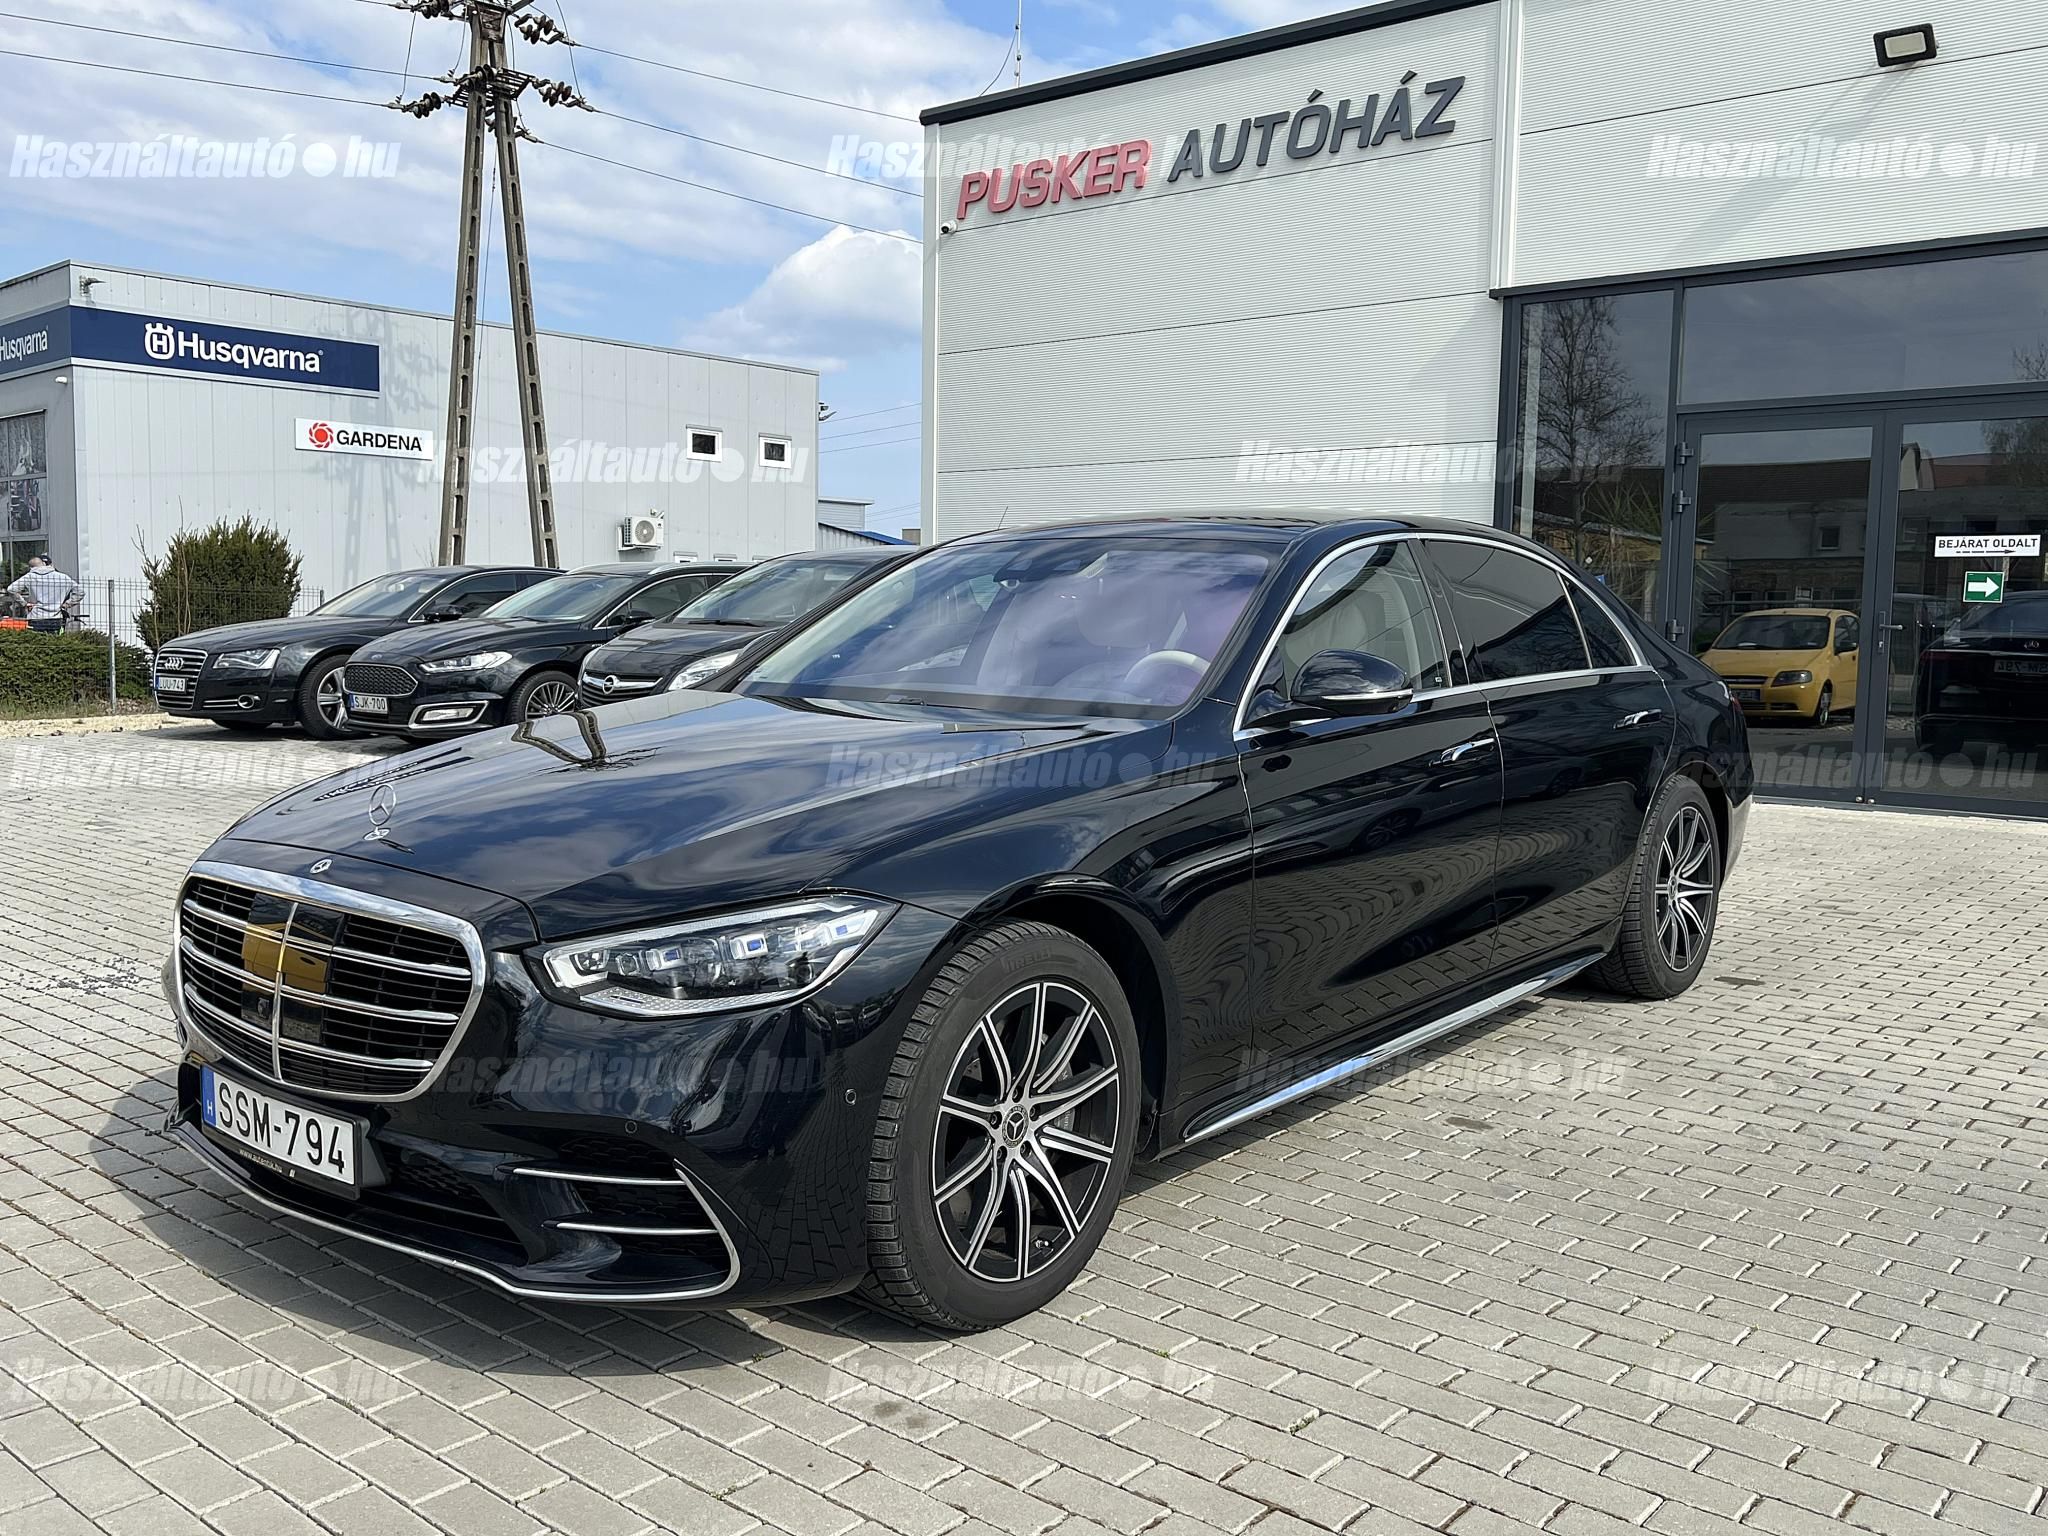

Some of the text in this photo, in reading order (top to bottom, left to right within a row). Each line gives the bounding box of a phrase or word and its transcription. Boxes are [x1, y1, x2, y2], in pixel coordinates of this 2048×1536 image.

[957, 70, 1466, 219] PUSKER AUTÓHÁZ
[0, 330, 48, 361] Husqvarna
[177, 331, 320, 373] Husqvarna
[336, 430, 422, 451] GARDENA
[1938, 537, 2038, 549] BEJÁRAT OLDALT
[354, 696, 386, 710] SJK-700
[206, 1082, 346, 1174] H SSM-794
